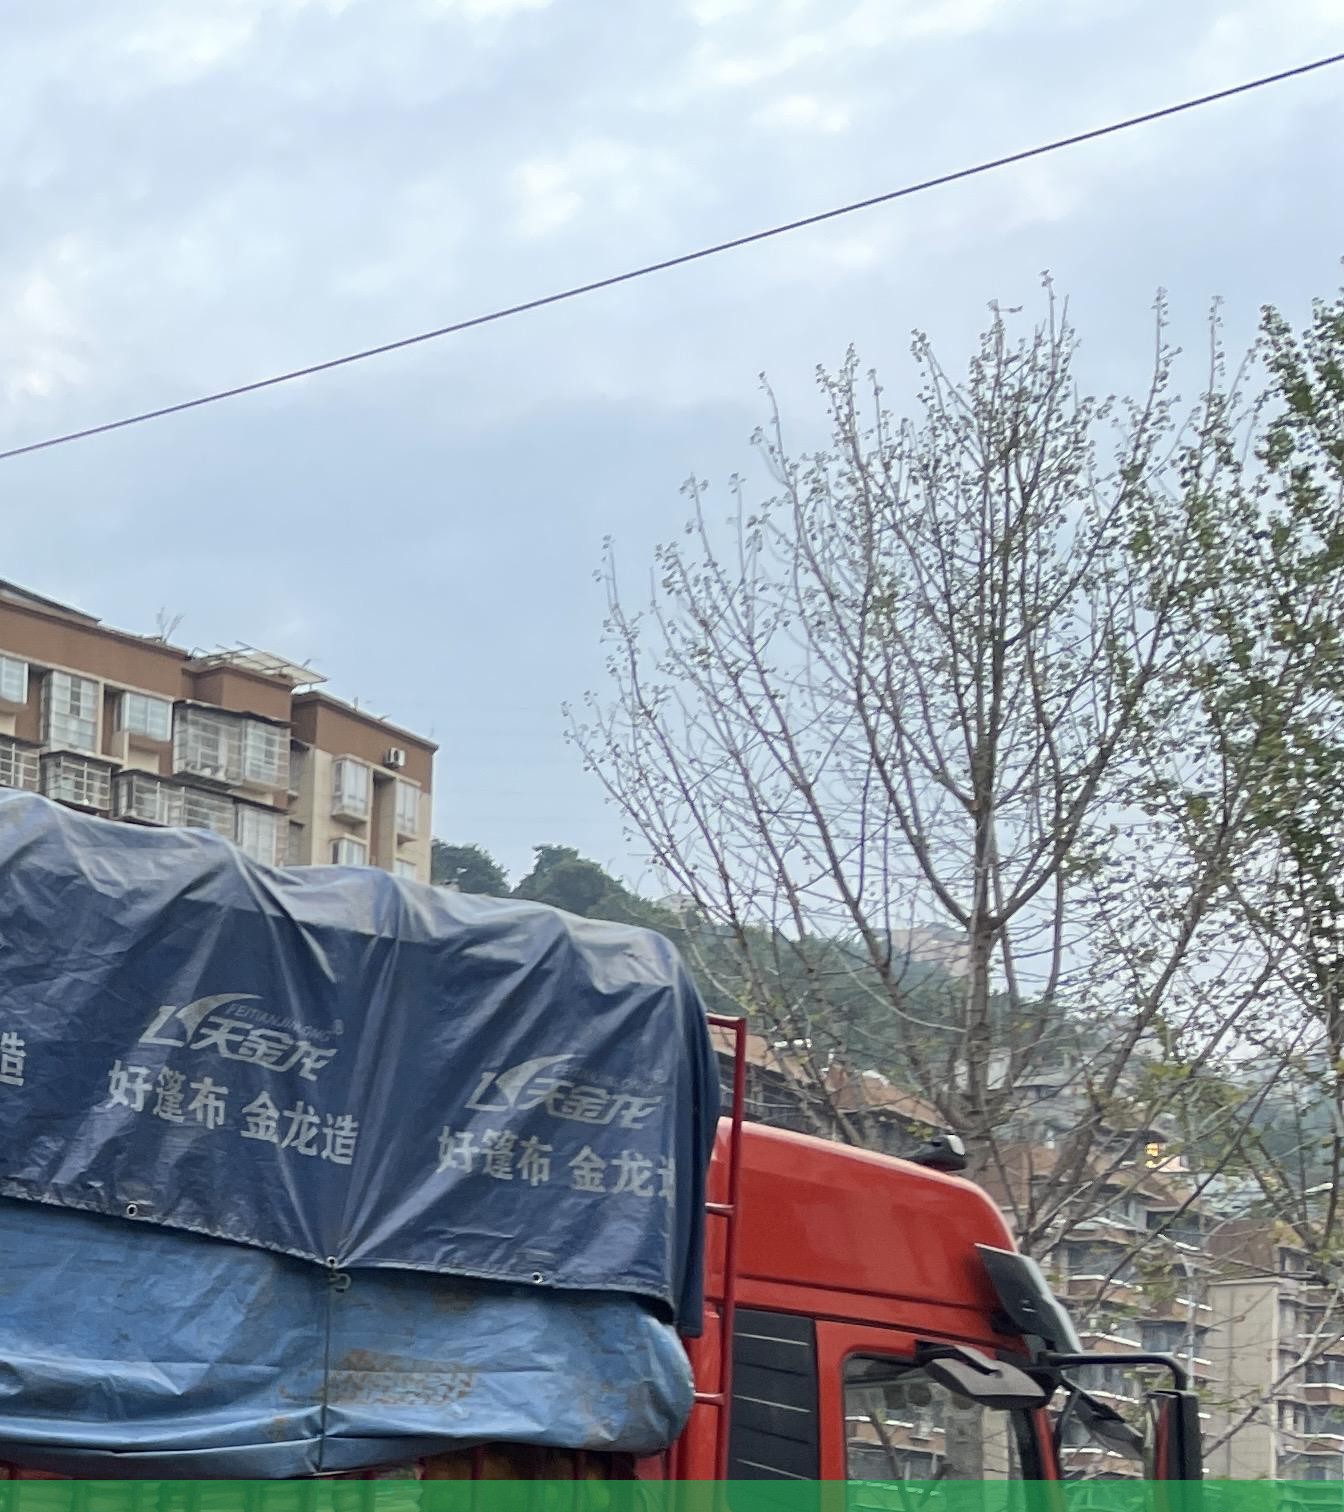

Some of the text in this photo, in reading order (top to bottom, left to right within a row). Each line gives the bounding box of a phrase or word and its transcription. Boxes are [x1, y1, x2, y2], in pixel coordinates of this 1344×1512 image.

[104, 1059, 360, 1166] 好篷布 金龙造
[435, 1125, 554, 1187] 好篷布
